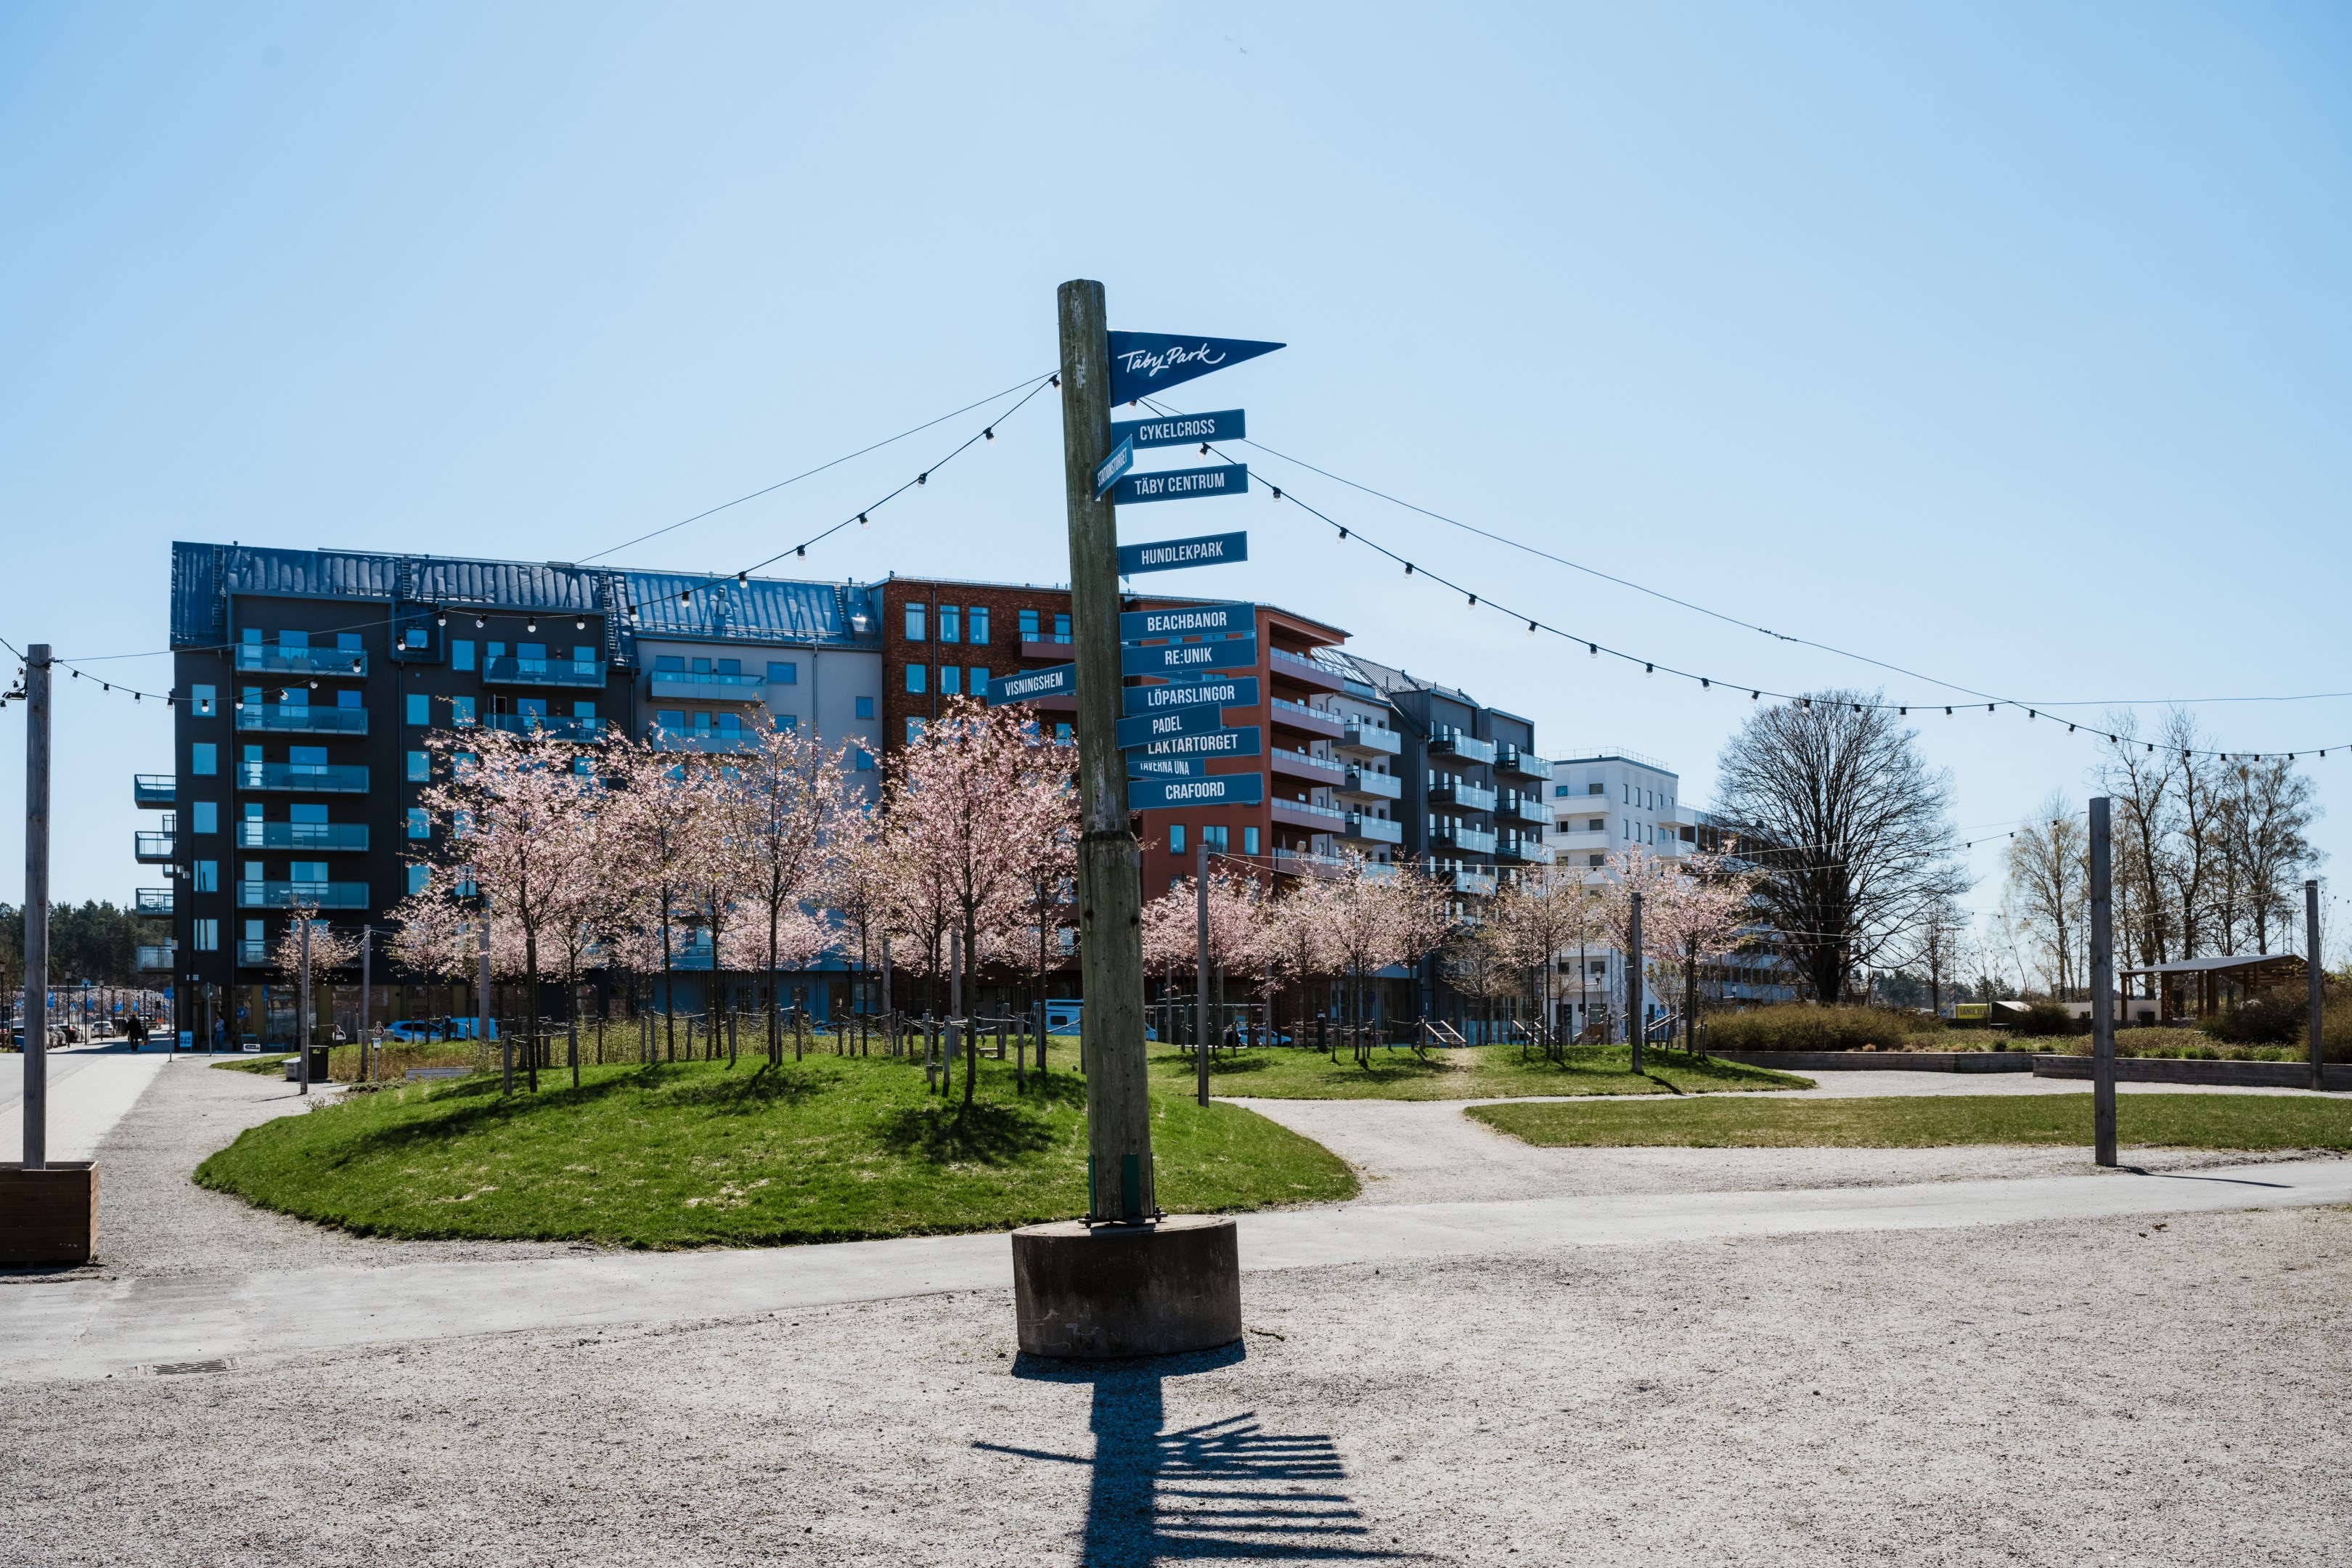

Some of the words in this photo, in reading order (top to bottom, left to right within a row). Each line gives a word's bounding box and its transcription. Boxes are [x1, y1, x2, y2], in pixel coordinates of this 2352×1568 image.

[1117, 349, 1169, 377] Täby
[1166, 343, 1226, 364] Park
[1139, 418, 1216, 441] CYKELCROSS
[1097, 447, 1127, 487] STATIONSTORGET
[1135, 477, 1164, 495] TÄBY
[1168, 472, 1225, 492] CENTRUM
[1141, 541, 1224, 565] HUNDLEKPARK
[1147, 611, 1227, 632] BEACHBANOR
[1164, 647, 1212, 665] RE:UNIK
[1005, 671, 1063, 696] VISNINGSHEM
[1148, 685, 1235, 706] LÖPARSLINGOR
[1153, 715, 1183, 735] PADEL
[1174, 760, 1190, 775] UNA
[1165, 781, 1225, 800] CRAFOORD
